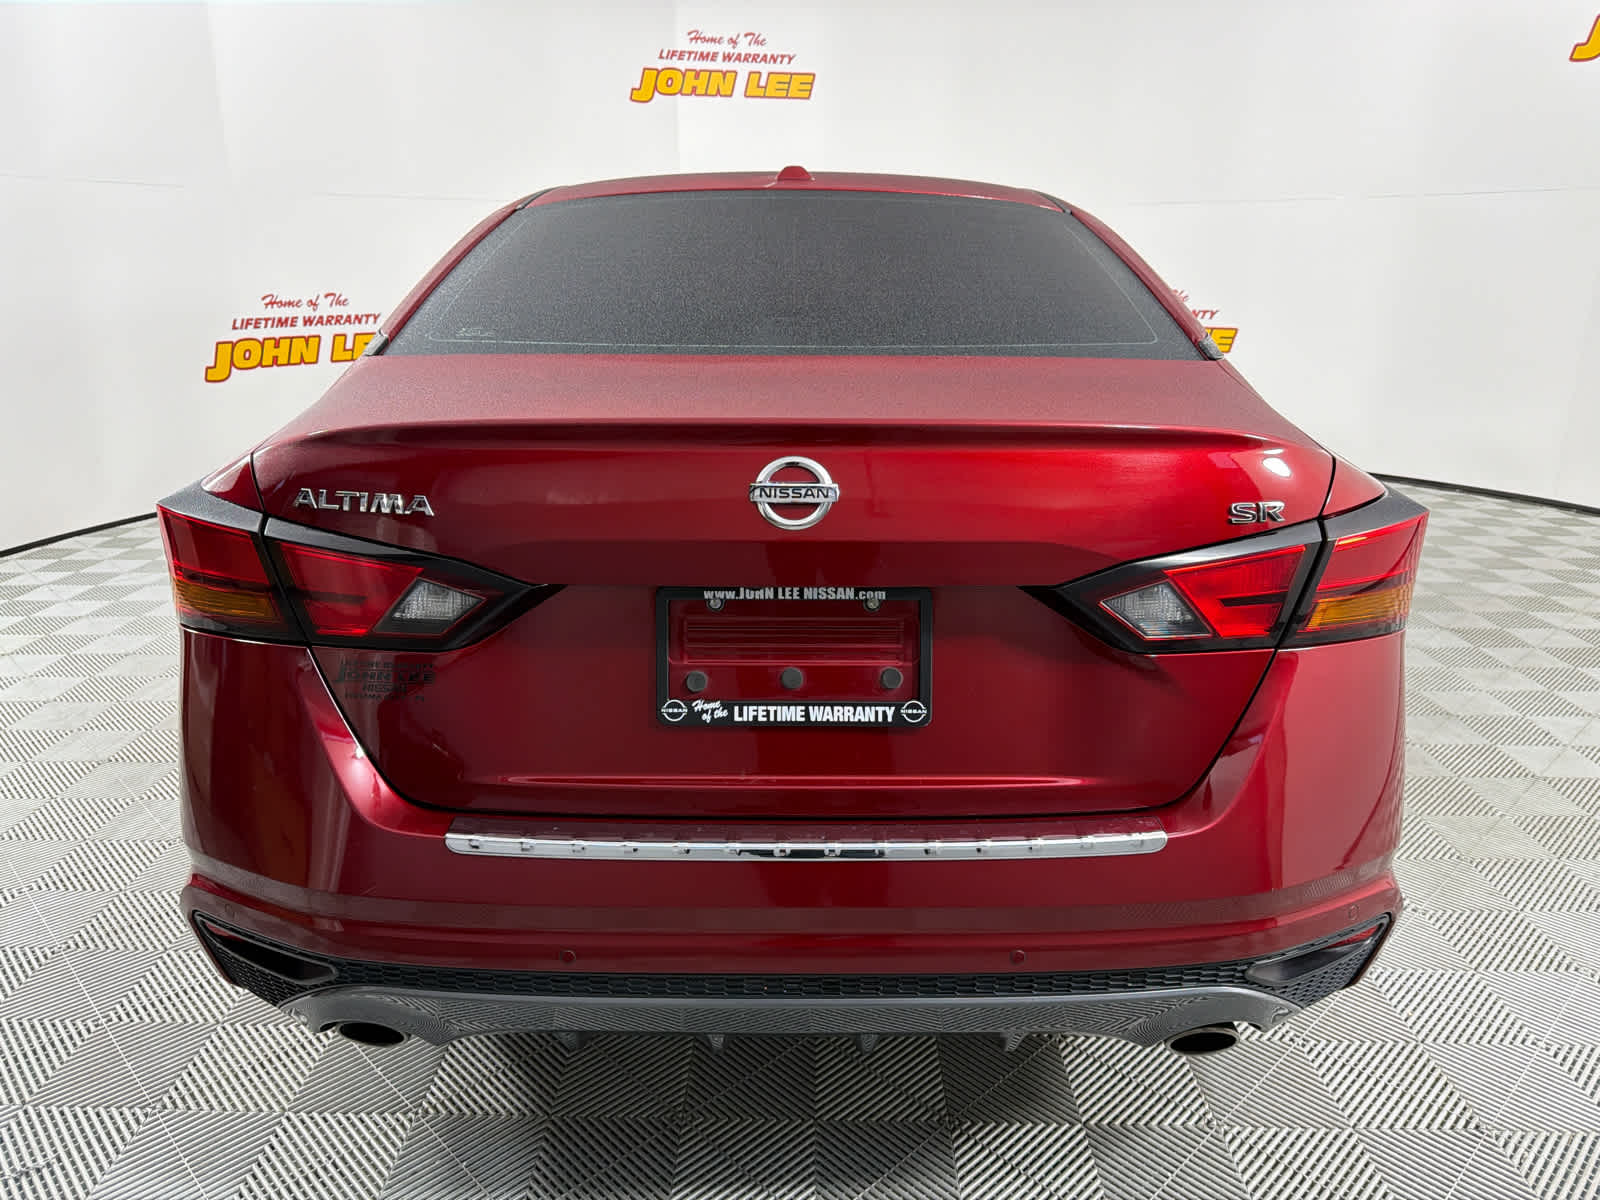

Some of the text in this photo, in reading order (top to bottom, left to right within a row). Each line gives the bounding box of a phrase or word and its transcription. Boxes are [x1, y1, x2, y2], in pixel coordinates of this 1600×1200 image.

[687, 29, 767, 49] Home of The
[658, 49, 796, 65] LIFETIME WARRANTY
[629, 67, 816, 103] JOHN LEE
[261, 292, 348, 311] Home of The
[232, 313, 381, 331] LIFETIME WARRANTY
[205, 335, 321, 383] JOHN
[759, 486, 829, 499] NISSAN
[293, 487, 434, 517] ALTIMA
[1228, 500, 1286, 524] SR
[778, 587, 800, 600] LEE
[803, 587, 886, 600] NISSAN.com
[691, 699, 721, 712] Home
[733, 705, 895, 722] LIFETIME WARRANTY
[701, 708, 728, 724] of the
